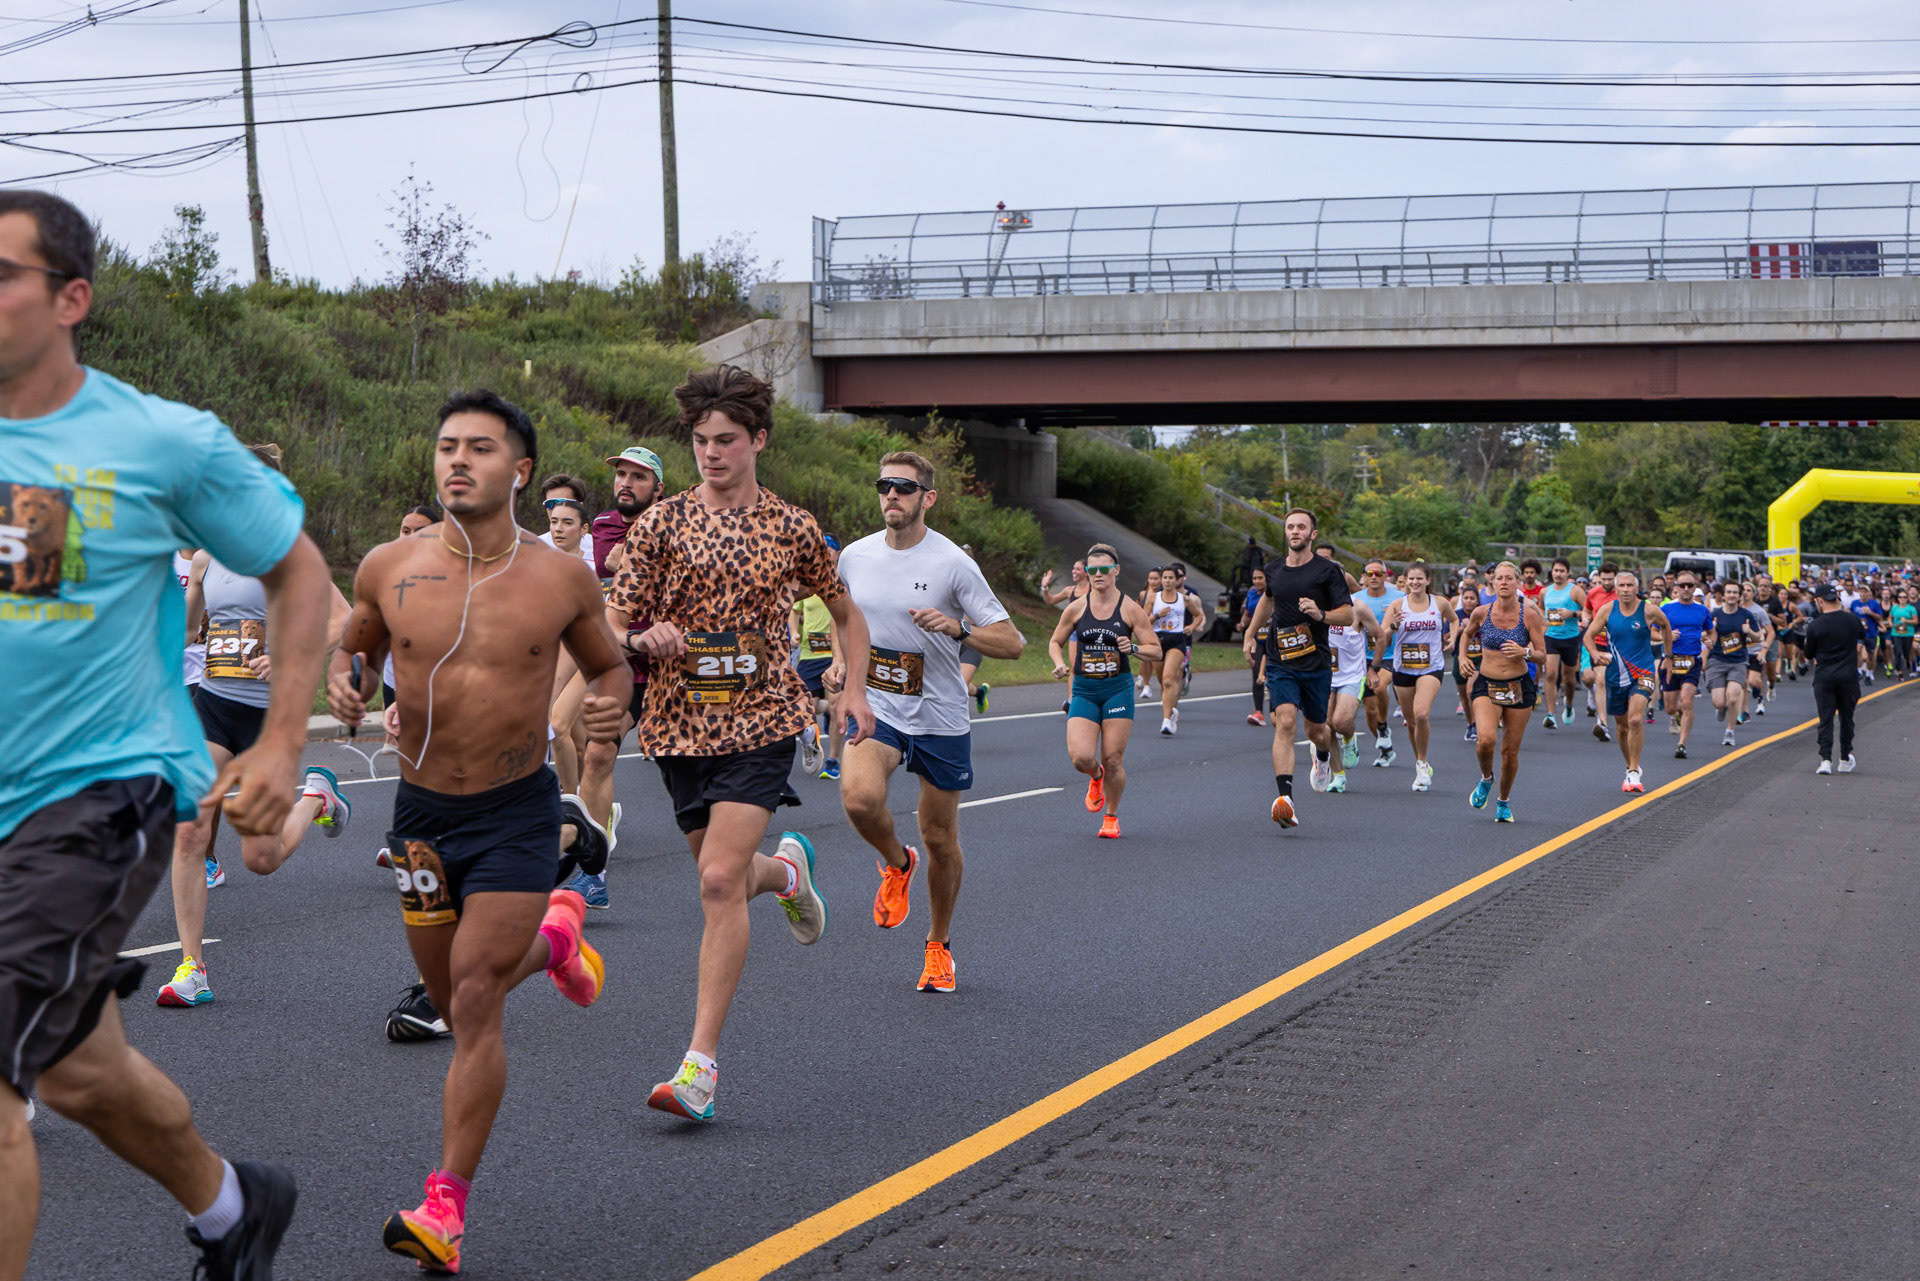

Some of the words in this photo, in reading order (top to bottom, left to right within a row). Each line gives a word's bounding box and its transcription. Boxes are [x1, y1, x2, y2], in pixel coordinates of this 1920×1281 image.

[1404, 620, 1437, 628] LEONIA
[1082, 628, 1118, 639] PRINCETON
[208, 637, 259, 655] 237
[1281, 634, 1308, 648] 132
[1402, 651, 1428, 659] 236
[697, 654, 757, 676] 213
[1084, 662, 1117, 673] 332
[875, 664, 909, 684] 53
[1495, 690, 1515, 700] 24
[1108, 706, 1126, 714] HOKA
